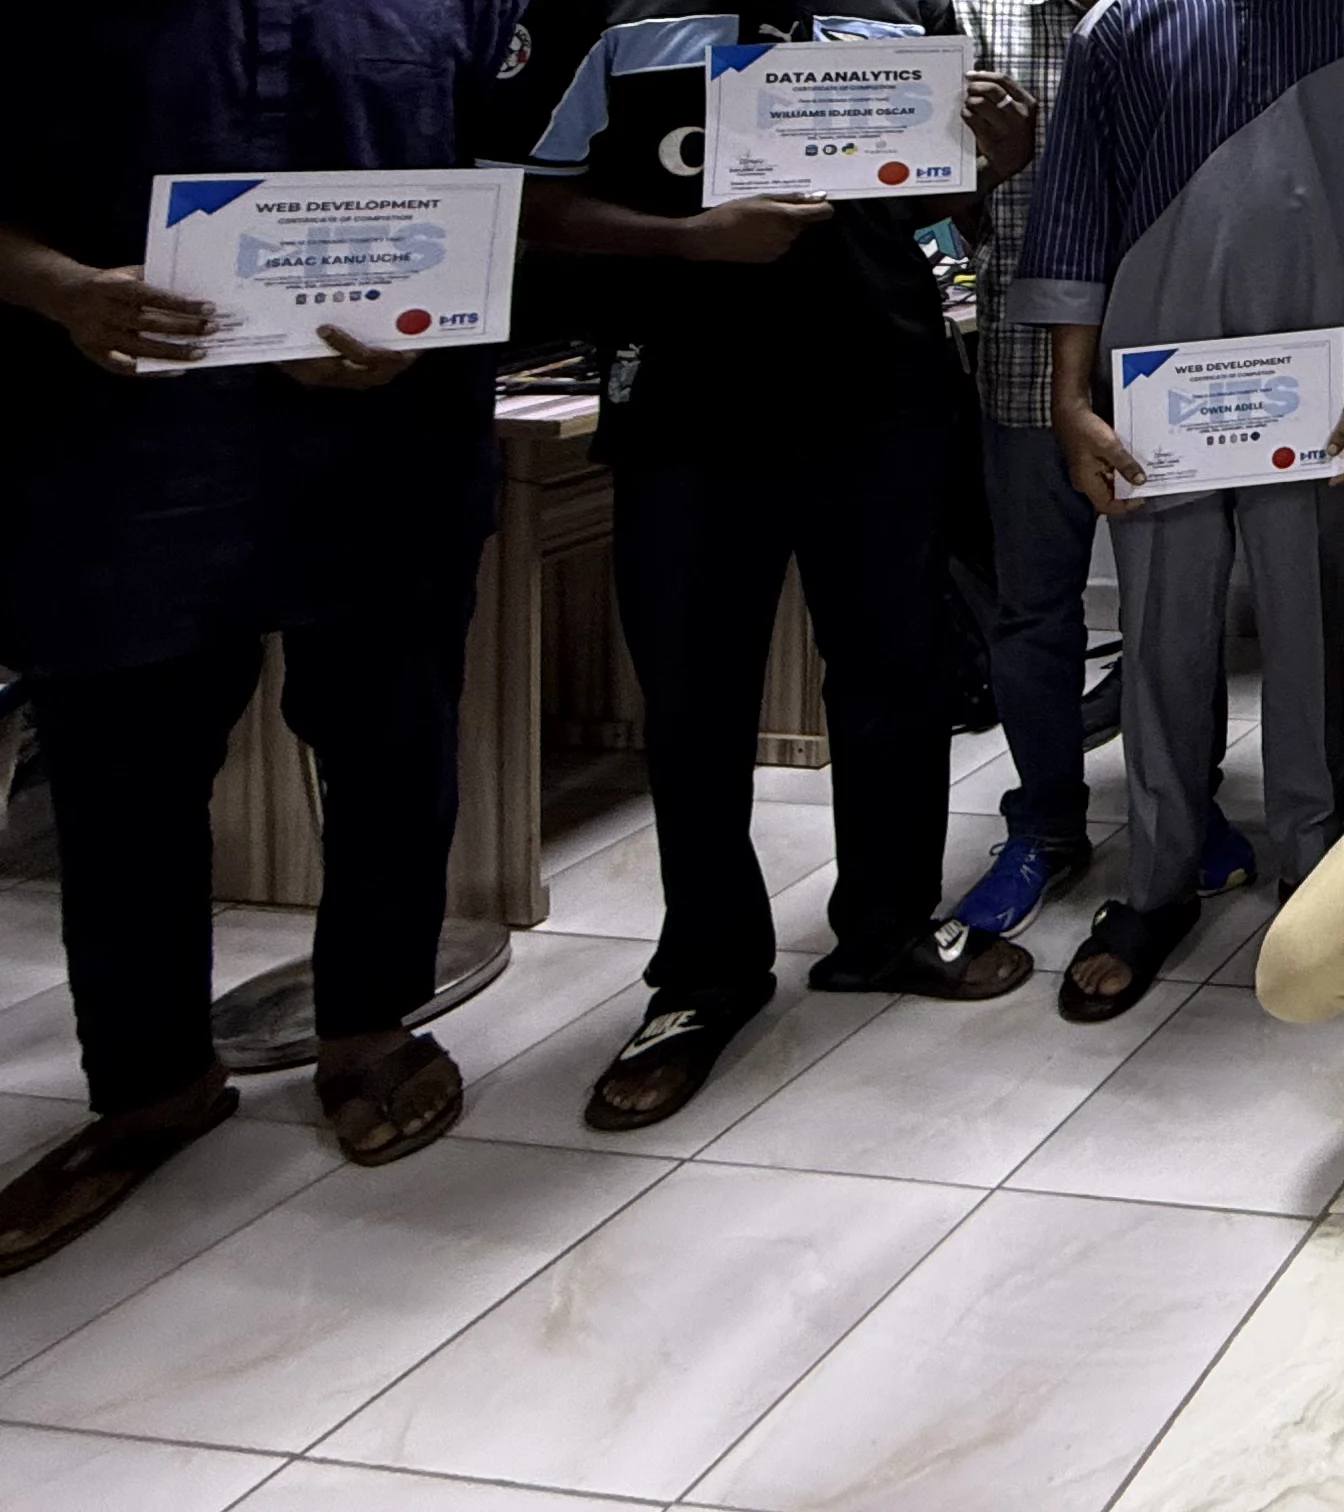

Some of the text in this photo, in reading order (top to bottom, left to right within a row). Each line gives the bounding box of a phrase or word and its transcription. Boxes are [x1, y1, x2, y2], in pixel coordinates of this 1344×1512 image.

[765, 70, 922, 83] DATA ANALYTICS
[769, 110, 826, 119] WILLIAMS
[256, 199, 441, 214] WEB DEVELOPMENT
[266, 252, 412, 268] ISAAC KANU UCHE
[1175, 356, 1292, 374] WEB DEVELOPMENT
[1200, 402, 1264, 415] OWEN ADELE
